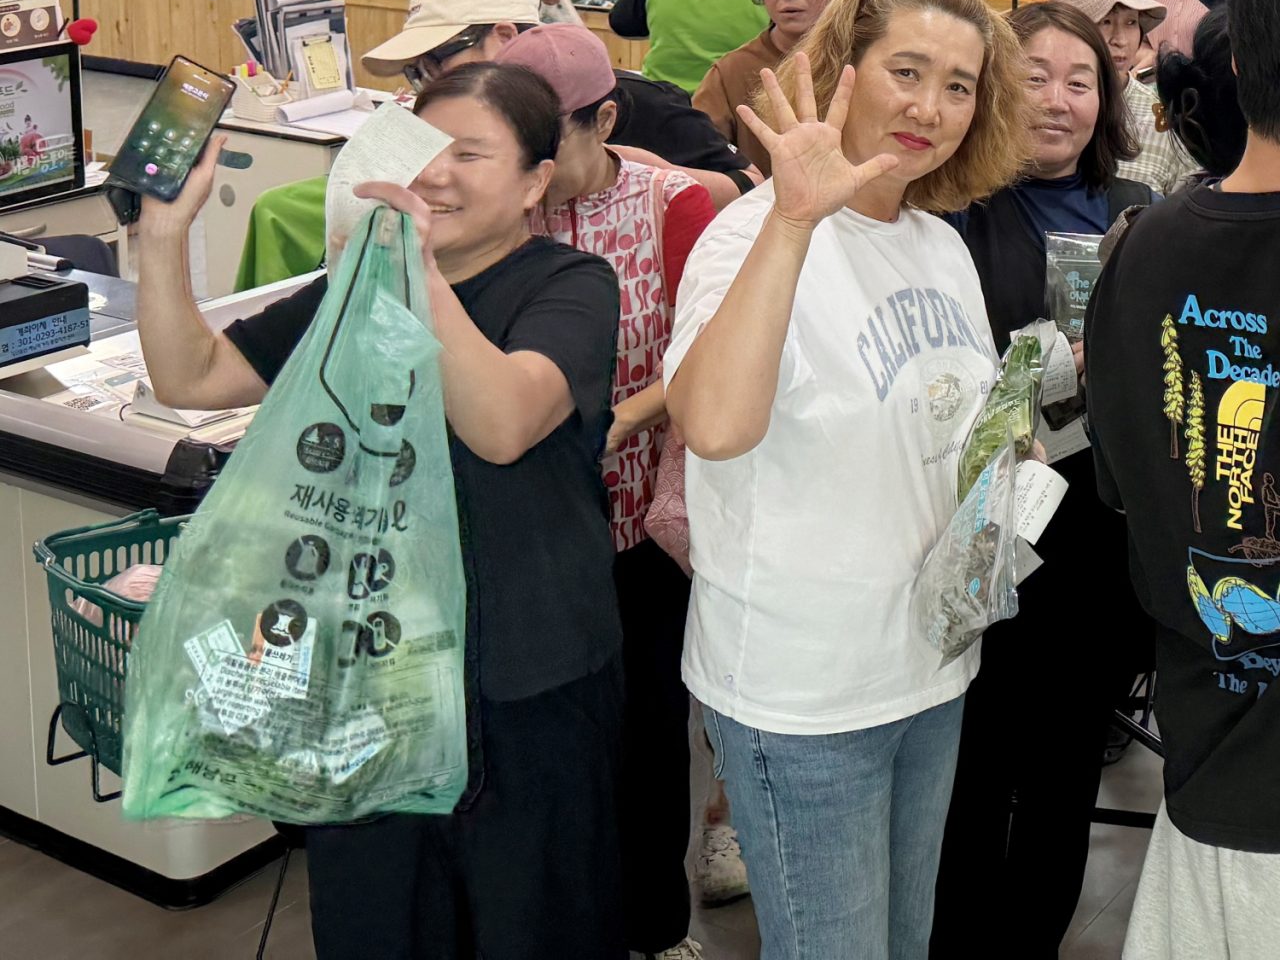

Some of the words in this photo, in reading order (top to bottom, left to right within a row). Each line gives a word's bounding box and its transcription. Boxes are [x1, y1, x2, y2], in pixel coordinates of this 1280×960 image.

[1178, 294, 1268, 335] Across
[1229, 335, 1262, 360] The
[1216, 424, 1234, 481] THE
[1239, 430, 1259, 504] FACE
[1227, 427, 1249, 530] NORTH
[1213, 671, 1248, 694] The
